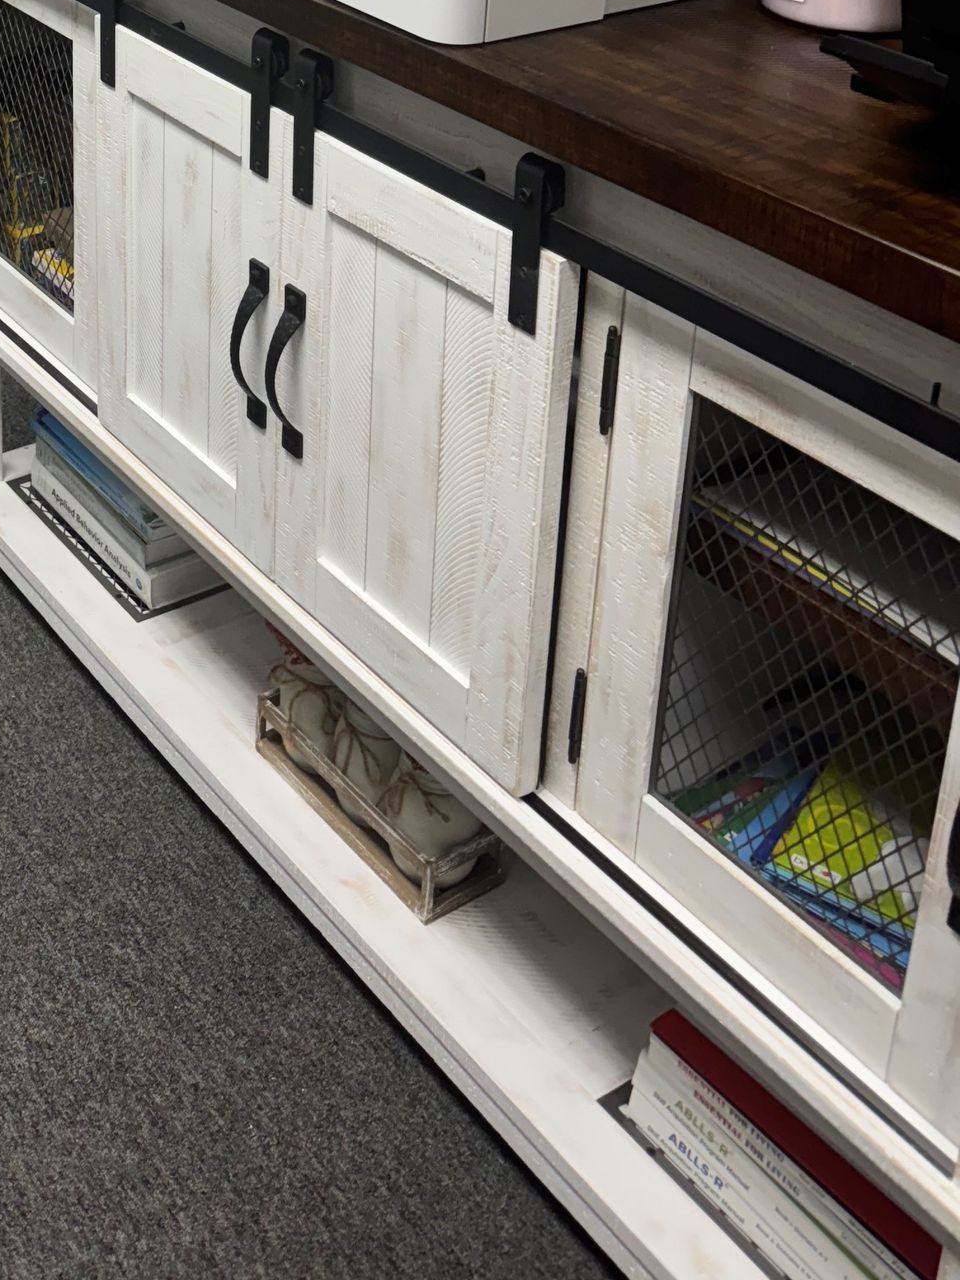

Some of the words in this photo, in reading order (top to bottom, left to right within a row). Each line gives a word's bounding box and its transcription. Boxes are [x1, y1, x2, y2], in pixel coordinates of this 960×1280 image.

[52, 488, 76, 519] Applied
[76, 515, 103, 549] Behavior
[104, 545, 132, 579] Analysis
[693, 1089, 742, 1141] ESSENTIAL
[745, 1139, 764, 1163] FOR
[766, 1158, 800, 1198] LIVING
[699, 1137, 726, 1168] Program
[726, 1166, 750, 1191] Manual
